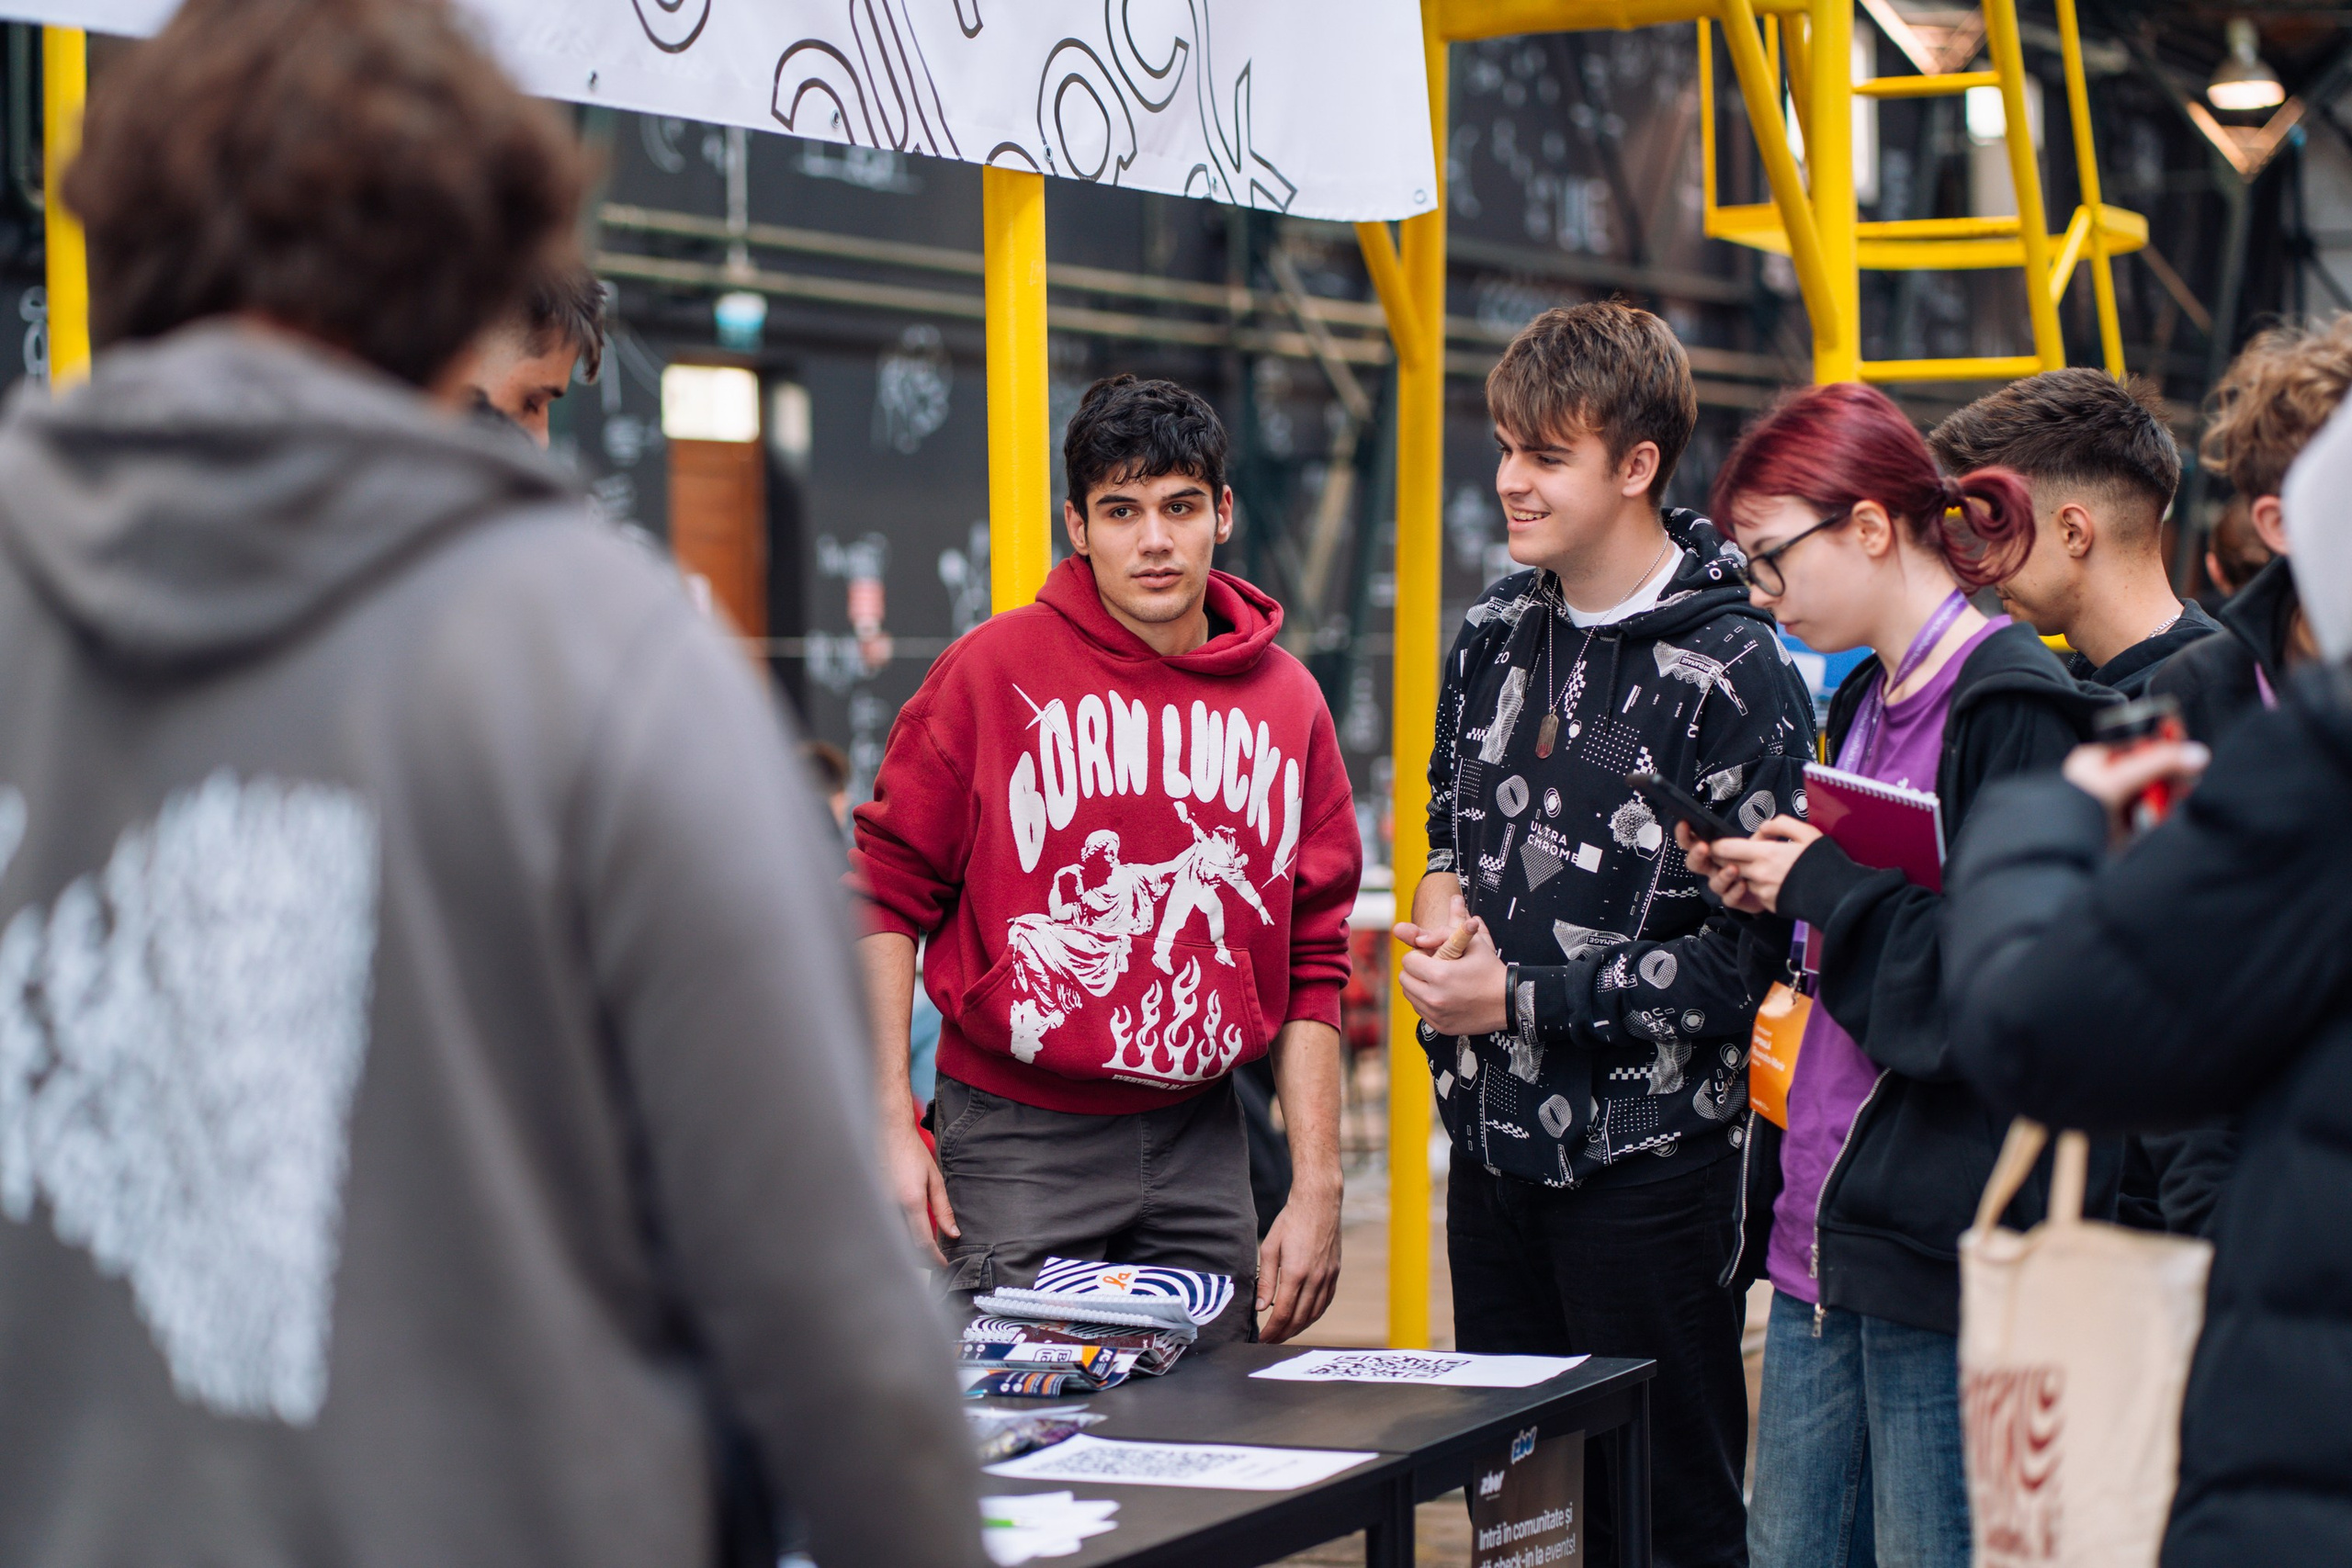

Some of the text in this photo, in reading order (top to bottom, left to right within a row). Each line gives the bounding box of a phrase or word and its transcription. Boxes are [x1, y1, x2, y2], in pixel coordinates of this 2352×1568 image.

[1009, 690, 1149, 874] BORN
[1527, 834, 1579, 864] CHROME
[1530, 820, 1567, 846] ULTRA
[1112, 1074, 1170, 1090] EVERYTHING
[1479, 1524, 1502, 1551] Intră
[1503, 1521, 1512, 1544] în
[1513, 1508, 1564, 1541] comunitate
[1535, 1544, 1544, 1567] la
[1544, 1533, 1577, 1563] events!
